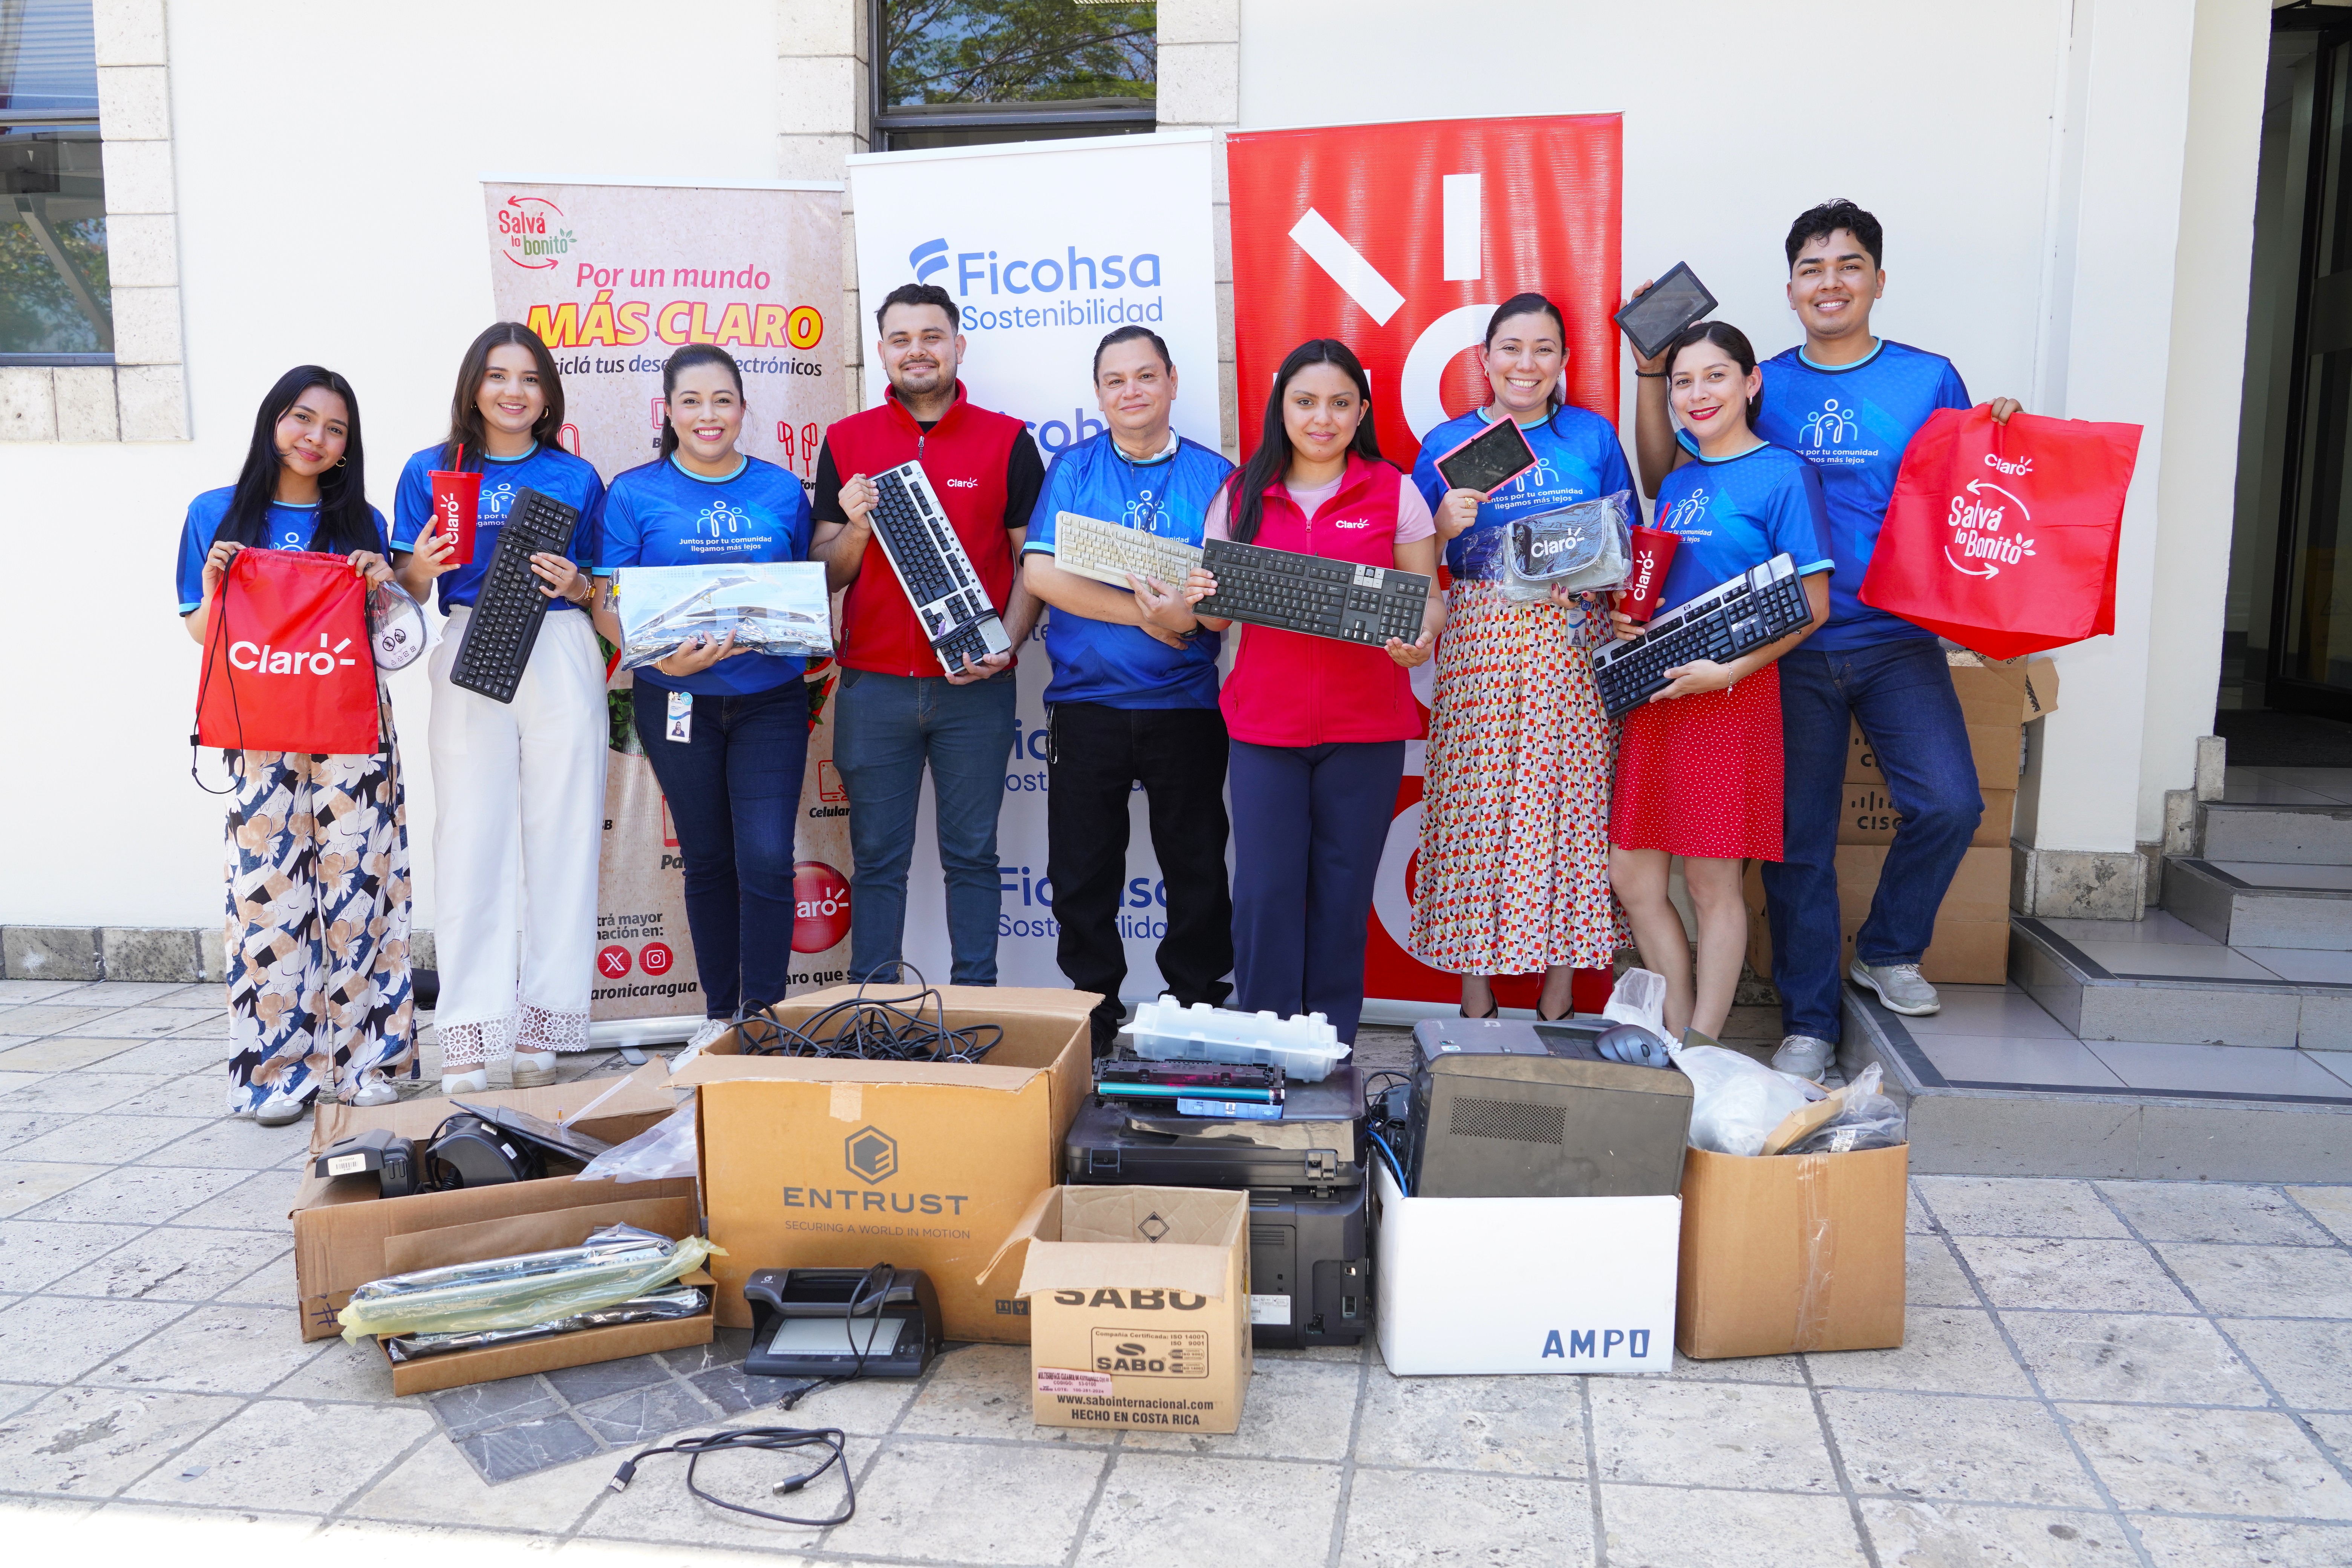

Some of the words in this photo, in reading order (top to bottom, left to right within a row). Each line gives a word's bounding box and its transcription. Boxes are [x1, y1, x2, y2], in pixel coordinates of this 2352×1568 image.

[499, 210, 545, 234] Salvá
[511, 235, 520, 247] lo
[523, 235, 567, 255] bonito
[577, 263, 624, 287] Por
[630, 269, 665, 287] un
[674, 264, 770, 289] mundo
[958, 246, 1161, 296] Ficohsa
[527, 289, 650, 349] MÁS
[657, 300, 823, 350] CLARO
[962, 296, 1163, 331] Sostenibilidad
[554, 356, 590, 375] iclá
[596, 358, 624, 374] tus
[730, 355, 822, 376] ectrónicos
[1984, 454, 2026, 476] Claro
[947, 479, 973, 488] Claro
[1495, 501, 1533, 510] llegamos
[1948, 496, 2005, 532] Salvá
[446, 501, 459, 544] Claro
[1336, 520, 1364, 529] Claro
[1531, 536, 1576, 557] Claro
[1955, 528, 1967, 544] lo
[1965, 530, 2021, 565] Bonito
[1634, 557, 1654, 601] Claro
[229, 641, 334, 675] Claro
[1857, 816, 1904, 830] CISC
[619, 913, 663, 926] mayor
[795, 900, 837, 918] aro
[642, 926, 663, 937] en:
[813, 970, 842, 986] que
[591, 982, 697, 1000] aronicaragua
[783, 1186, 968, 1215] ENTRUST
[785, 1220, 844, 1233] SECURING
[847, 1224, 855, 1233] A
[859, 1225, 903, 1236] WORLD
[908, 1228, 918, 1237] IN
[923, 1229, 970, 1239] MOTION
[1055, 1289, 1207, 1311] SABO
[1542, 1330, 1650, 1358] AMPO
[1096, 1357, 1165, 1372] SABO
[1057, 1395, 1214, 1410] www.sabointernacional.com
[1071, 1409, 1110, 1422] HECHO
[1114, 1412, 1129, 1423] EN
[1132, 1412, 1169, 1424] COSTA
[1172, 1414, 1199, 1425] RICA
